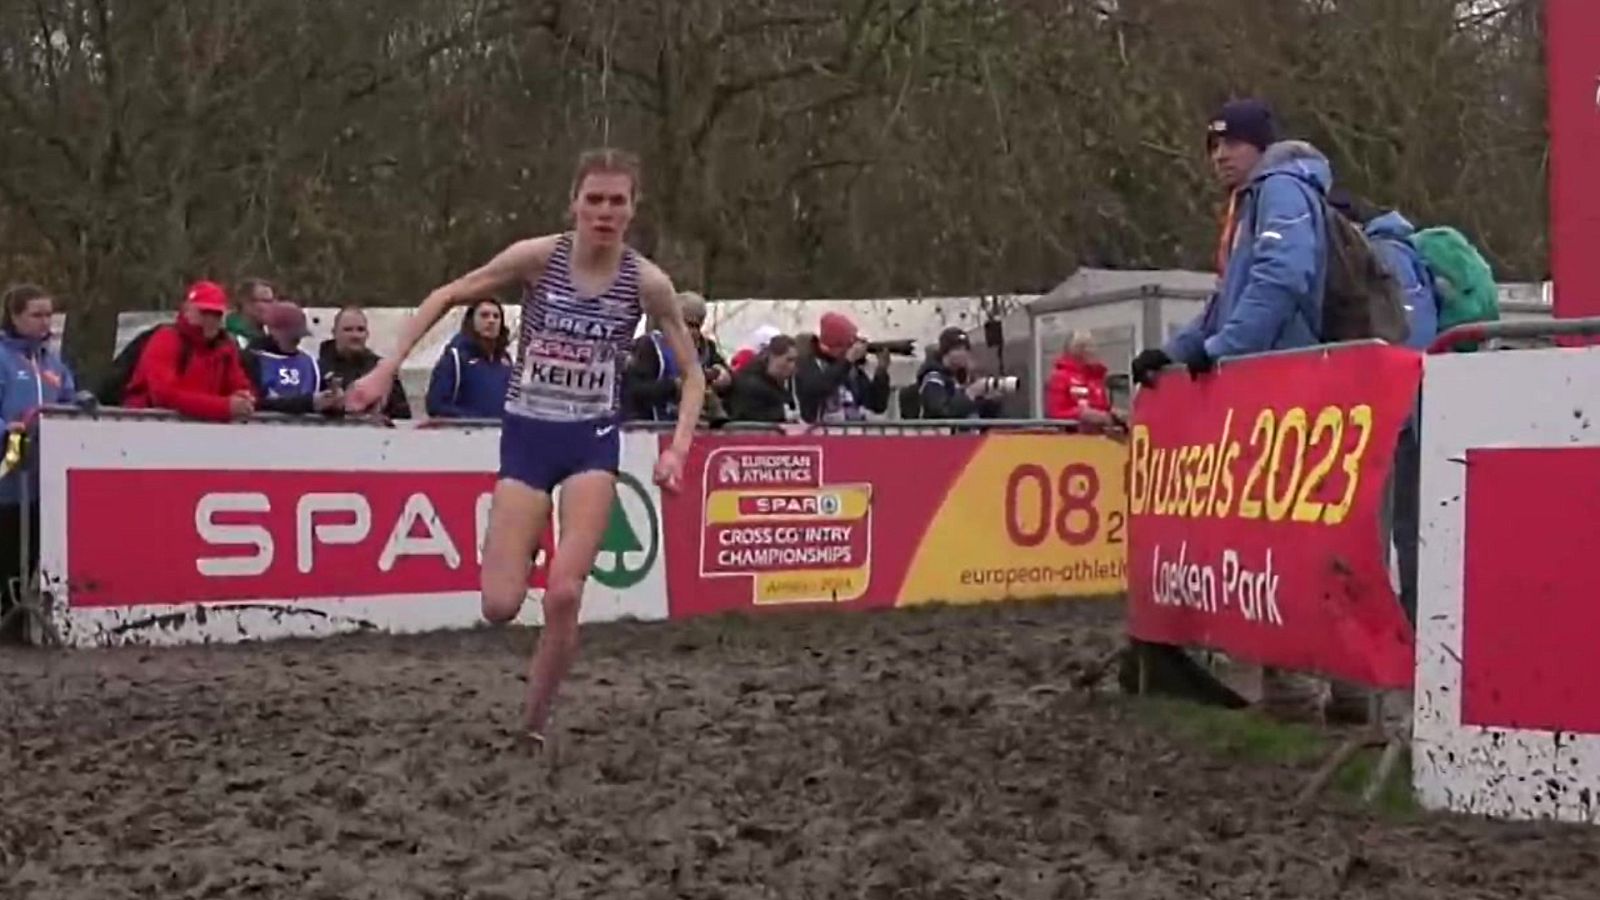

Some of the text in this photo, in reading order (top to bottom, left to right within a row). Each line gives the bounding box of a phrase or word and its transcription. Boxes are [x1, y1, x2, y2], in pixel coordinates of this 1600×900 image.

[278, 367, 301, 386] 58
[531, 361, 605, 390] KEITH
[741, 454, 811, 467] EUROPEAN
[1130, 404, 1373, 525] Brussels 2023
[743, 467, 812, 483] ATHLETICS
[755, 497, 816, 513] SPAR
[1004, 463, 1100, 547] 08
[194, 491, 546, 577] SPA
[718, 529, 772, 546] CROSS
[717, 546, 852, 566] CHAMPIONSHIPS
[1152, 540, 1283, 626] Laeken Park
